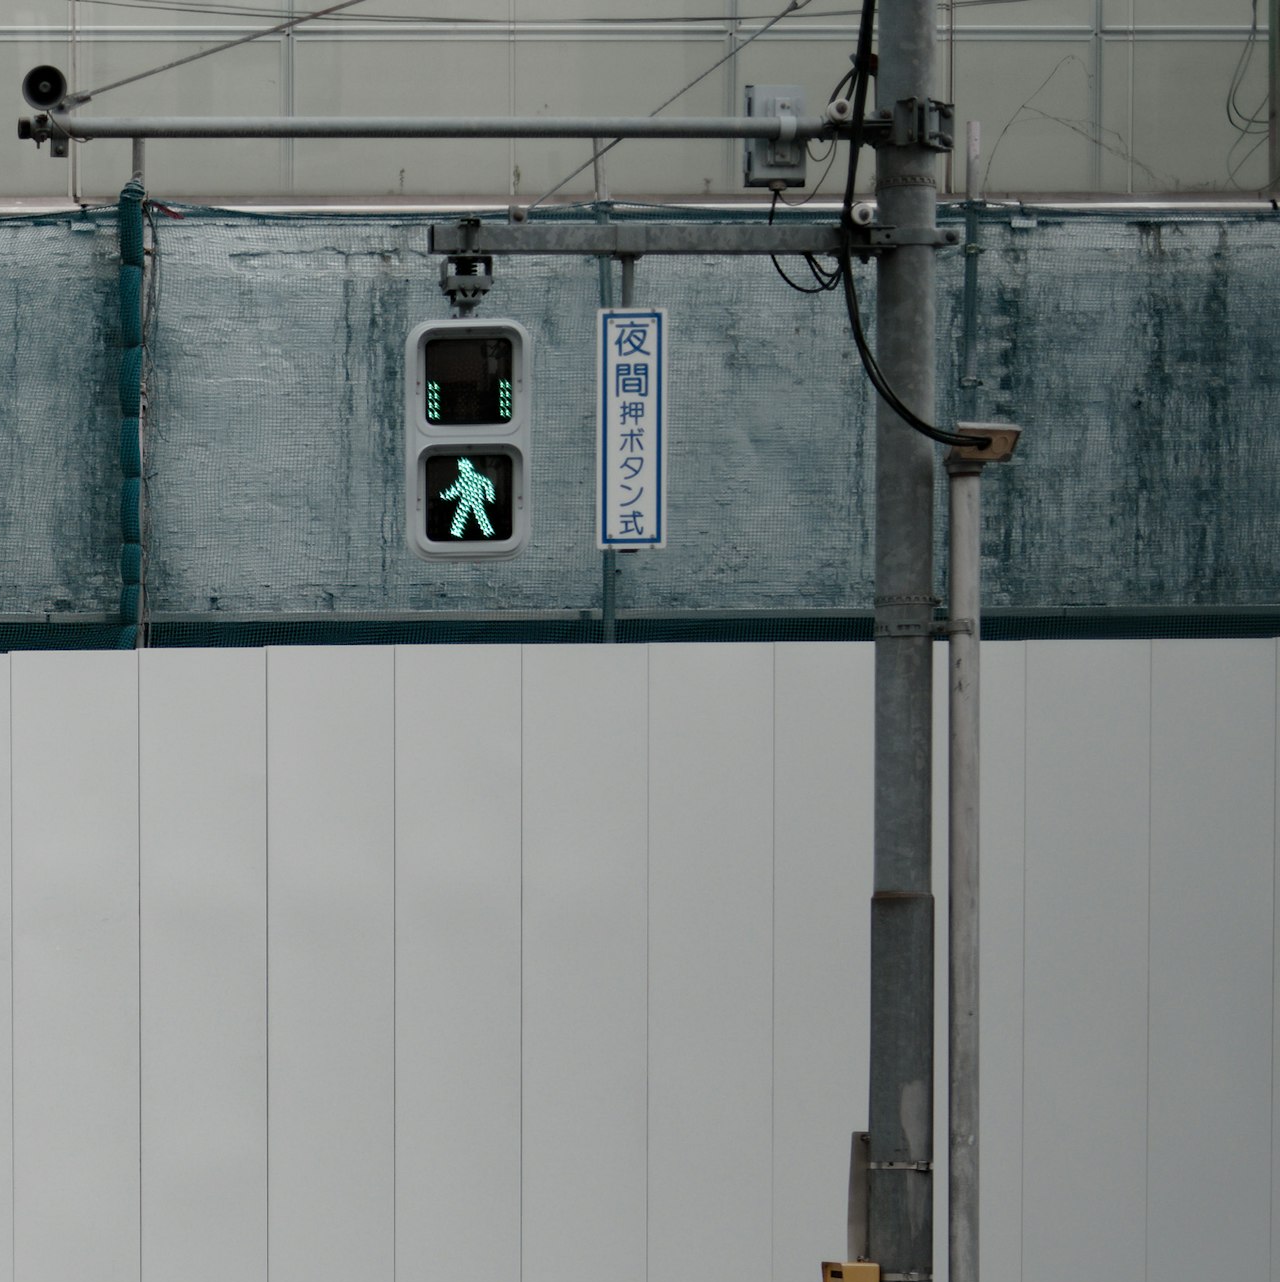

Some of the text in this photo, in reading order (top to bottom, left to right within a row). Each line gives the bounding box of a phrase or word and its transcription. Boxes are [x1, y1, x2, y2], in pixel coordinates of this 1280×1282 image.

[614, 321, 651, 536] 夜間押ボタン式
